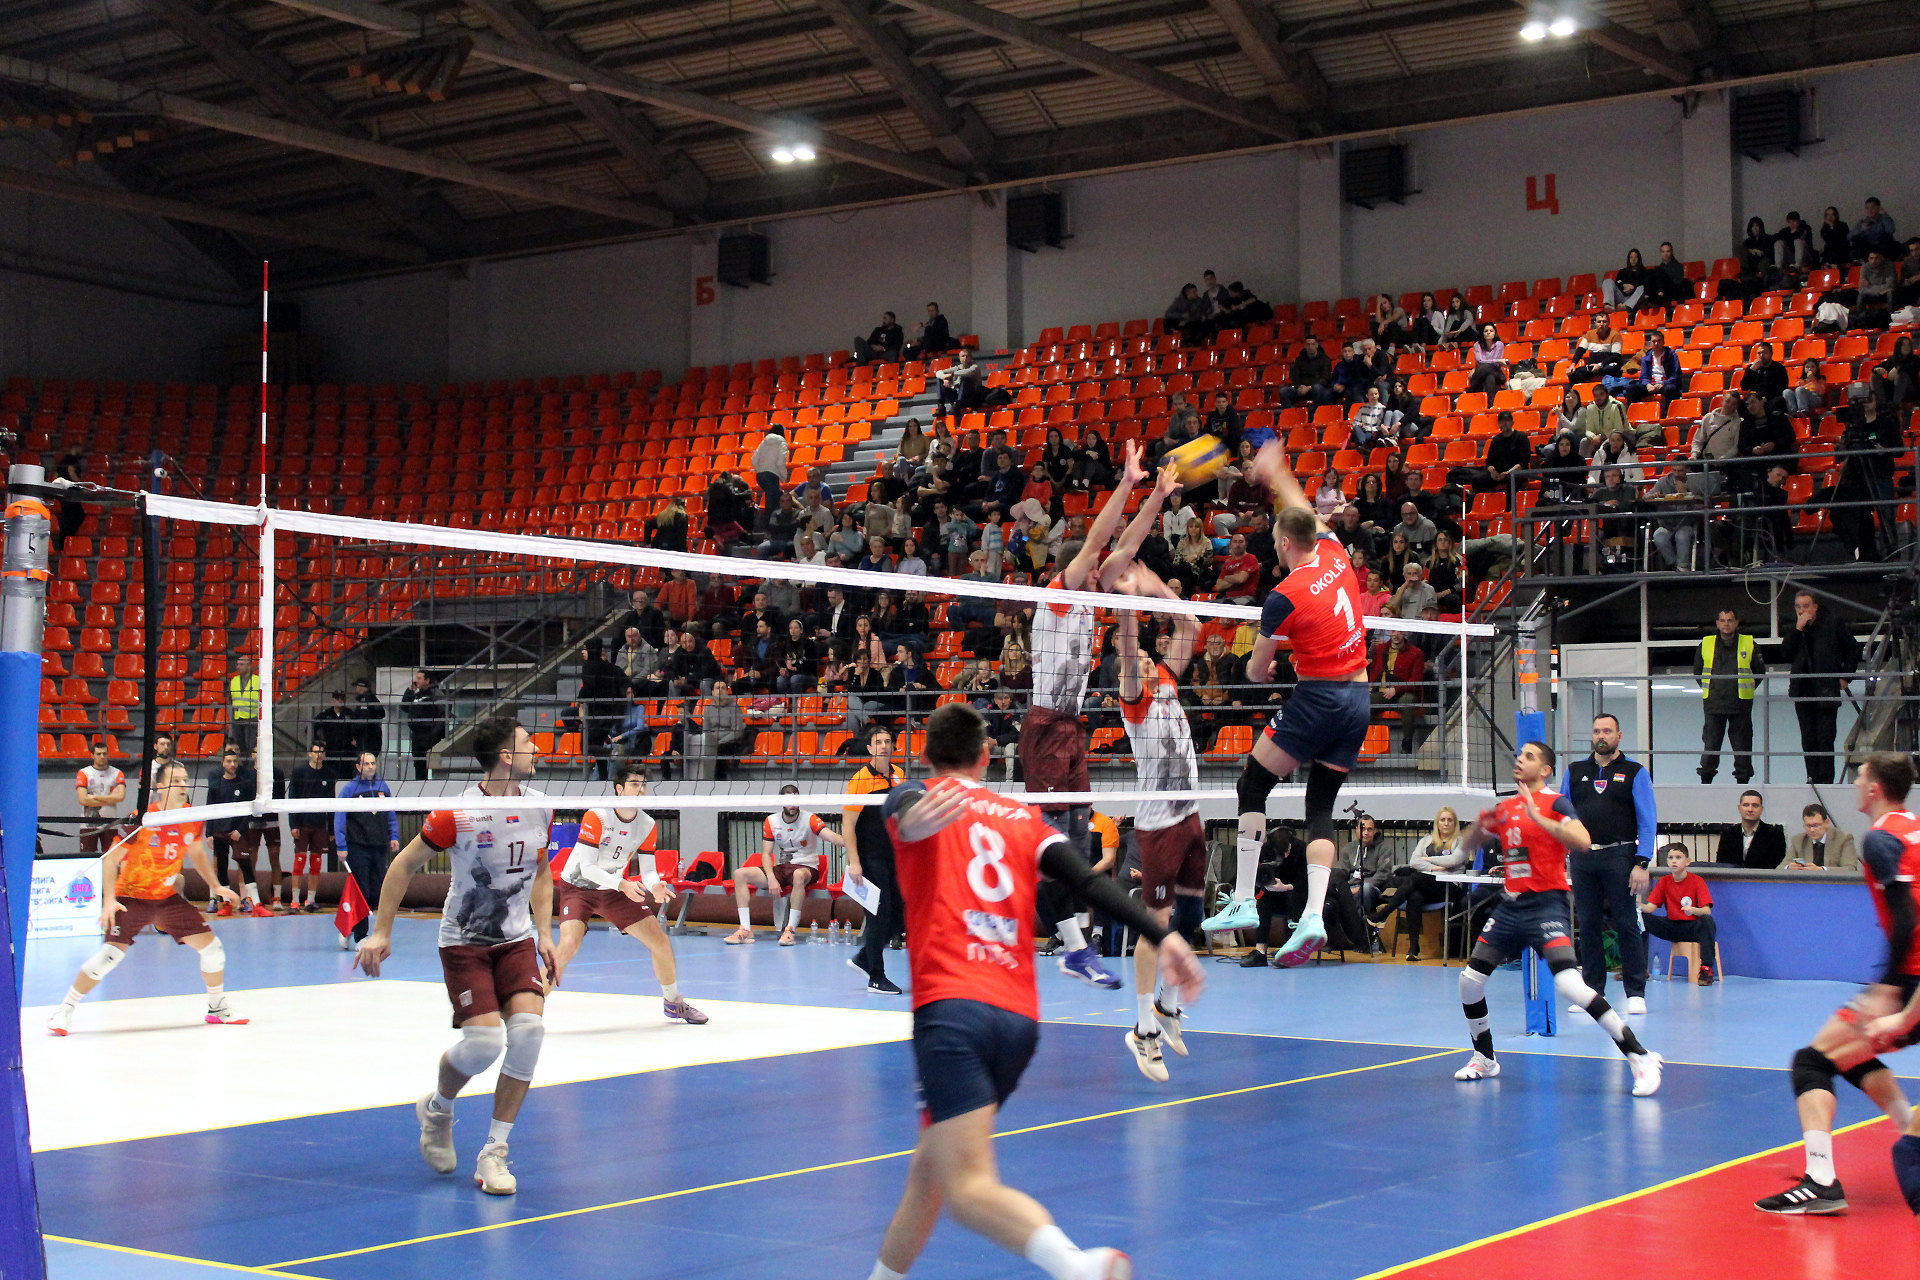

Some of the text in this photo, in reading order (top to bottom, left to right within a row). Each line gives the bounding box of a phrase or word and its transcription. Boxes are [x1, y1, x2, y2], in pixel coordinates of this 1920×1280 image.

[1526, 173, 1559, 215] Ц
[696, 276, 715, 306] Б
[1309, 557, 1347, 596] OKOLIĆ
[1333, 586, 1356, 633] 1
[164, 842, 179, 860] 15
[507, 840, 525, 867] 17
[612, 845, 623, 860] 6
[966, 821, 1015, 903] 8
[563, 906, 569, 915] 6
